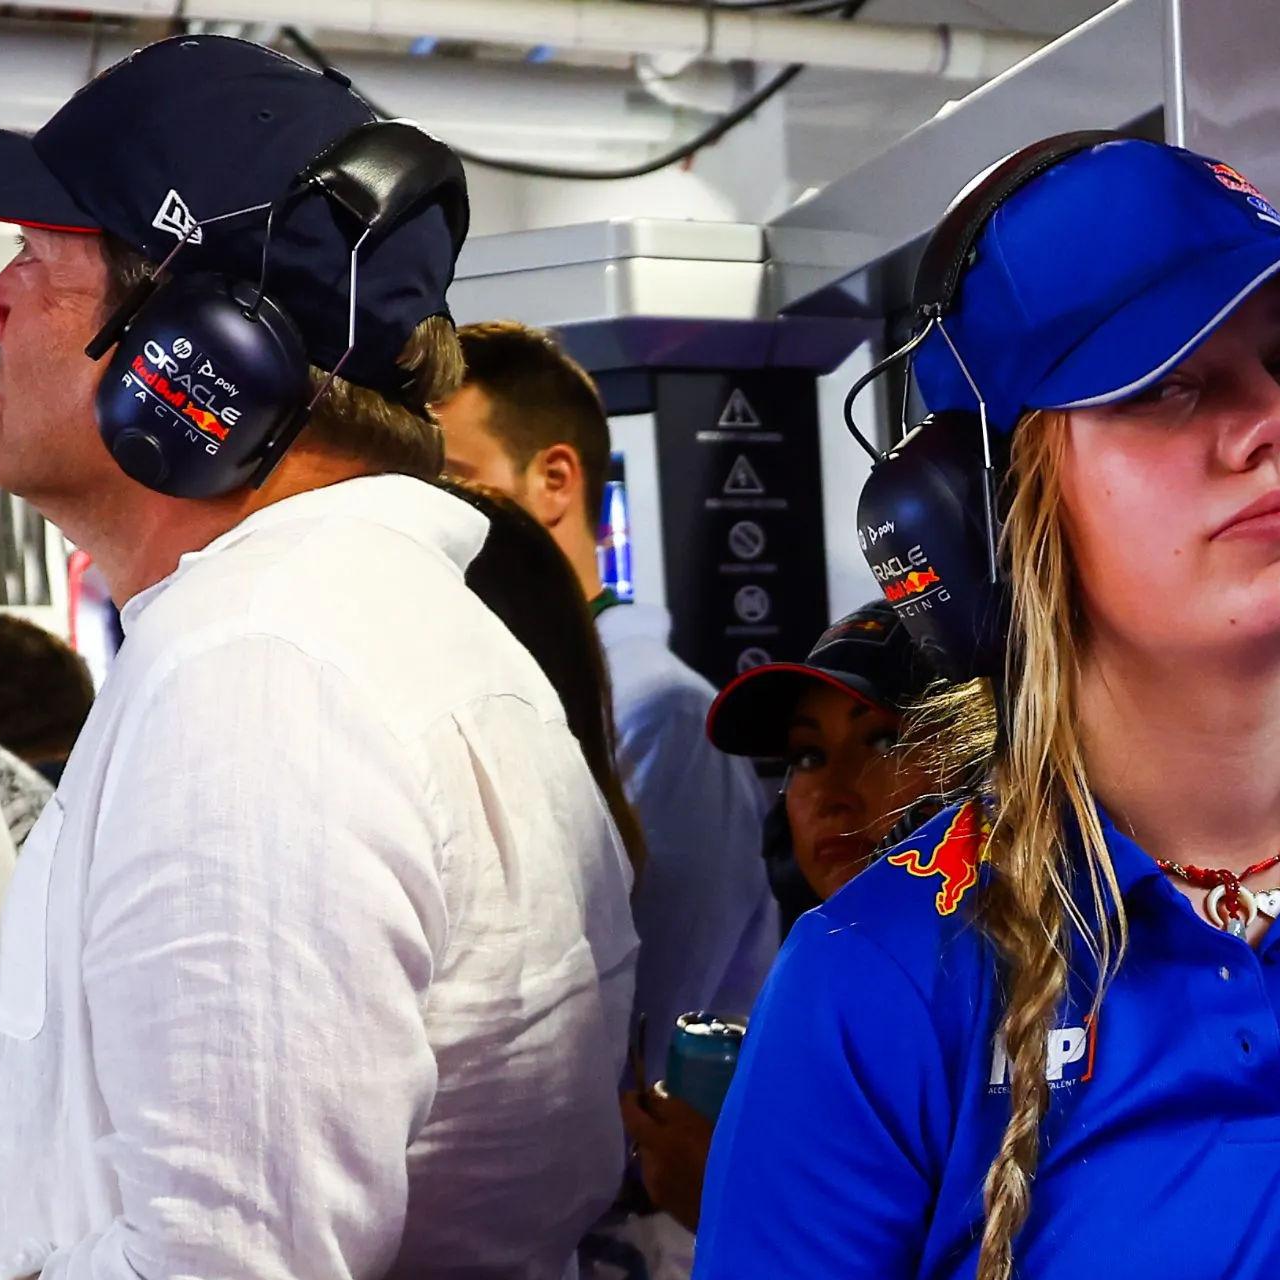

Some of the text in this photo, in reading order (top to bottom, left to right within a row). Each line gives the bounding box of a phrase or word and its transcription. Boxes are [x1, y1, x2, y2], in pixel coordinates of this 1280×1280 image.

[144, 340, 244, 427] ORACLE
[214, 377, 240, 398] poly
[121, 373, 221, 456] RACING
[878, 520, 895, 538] poly
[872, 544, 927, 581] RACLE
[898, 588, 951, 618] ACING
